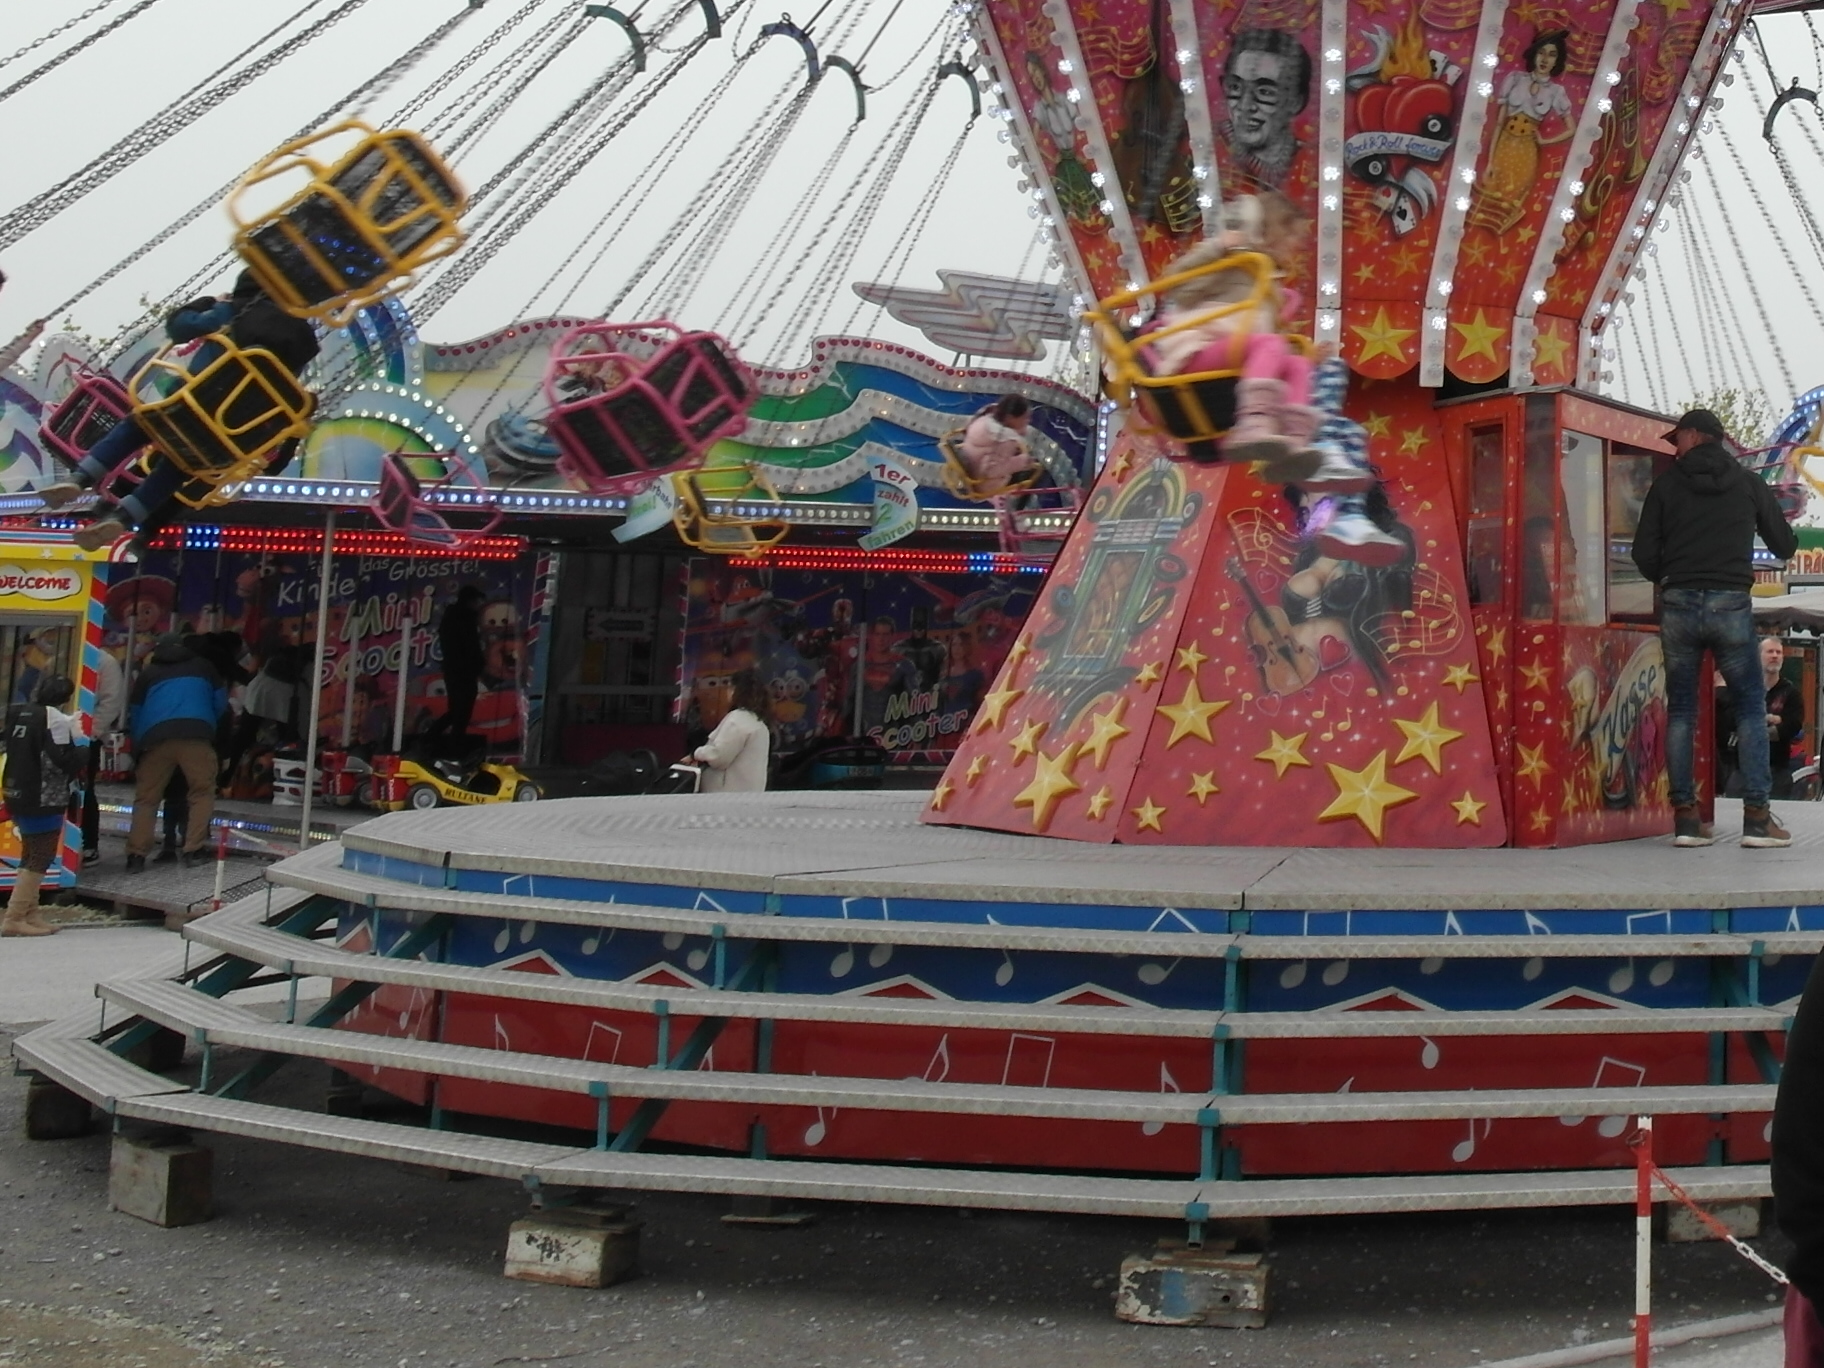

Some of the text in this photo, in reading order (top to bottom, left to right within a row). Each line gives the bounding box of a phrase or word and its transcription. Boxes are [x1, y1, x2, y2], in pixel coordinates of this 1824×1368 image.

[874, 463, 911, 485] 1er
[876, 502, 893, 526] 2
[877, 490, 909, 508] zahlt
[867, 520, 914, 548] fahren
[340, 584, 436, 642] Mini
[884, 683, 940, 724] Mini
[1603, 664, 1657, 759] Kasse
[866, 709, 969, 750] Scooter
